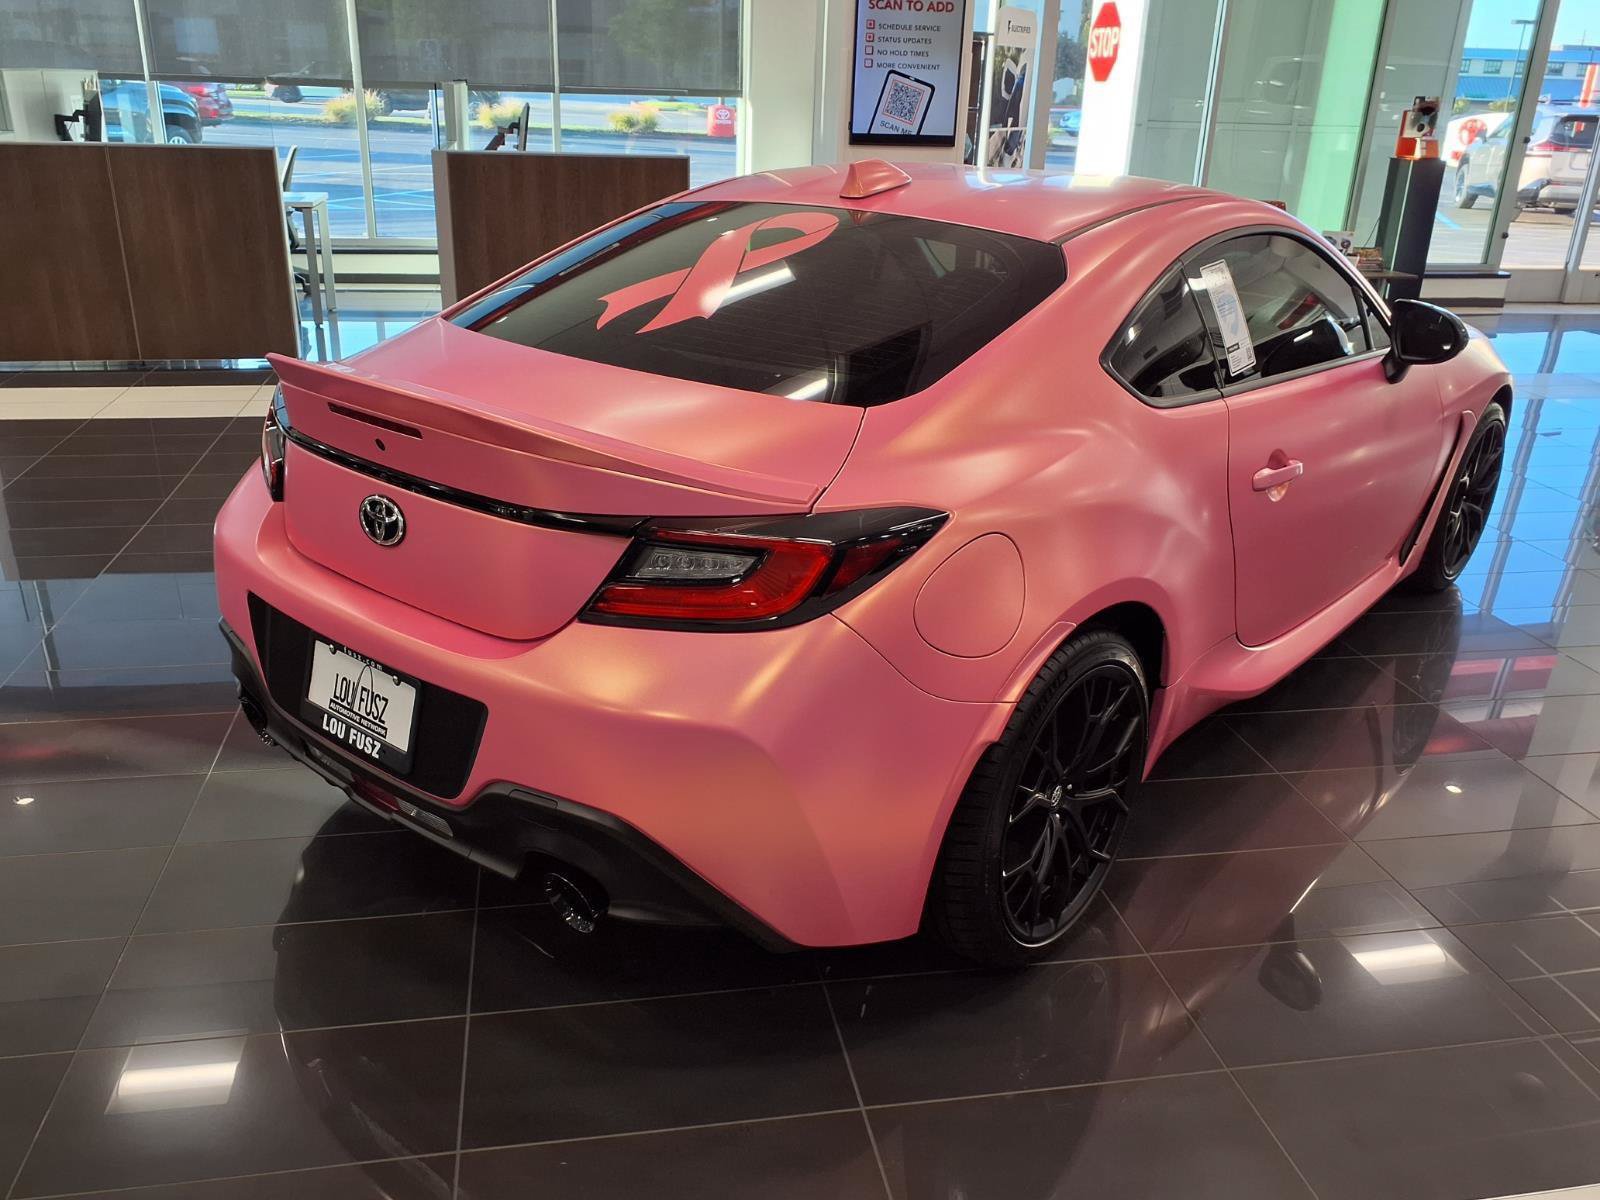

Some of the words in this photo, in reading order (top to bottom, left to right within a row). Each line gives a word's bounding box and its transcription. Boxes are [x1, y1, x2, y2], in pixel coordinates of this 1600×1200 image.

[868, 0, 902, 10] SCAN
[907, 0, 923, 12] TO
[926, 2, 954, 13] ADD
[878, 23, 913, 31] SCHEDULE
[914, 24, 941, 32] SERVICE
[902, 37, 932, 45] UPDATES
[1089, 27, 1120, 58] STOP
[897, 63, 941, 71] CONVENIENT
[880, 120, 900, 133] SCAN
[343, 646, 383, 671] fusz.com
[333, 673, 355, 706] LOU
[358, 686, 389, 725] FUSZ
[329, 703, 361, 723] AUTOMOTIVE
[360, 716, 387, 736] NETWORK
[322, 713, 346, 739] LOU
[348, 728, 381, 759] FUSZ
